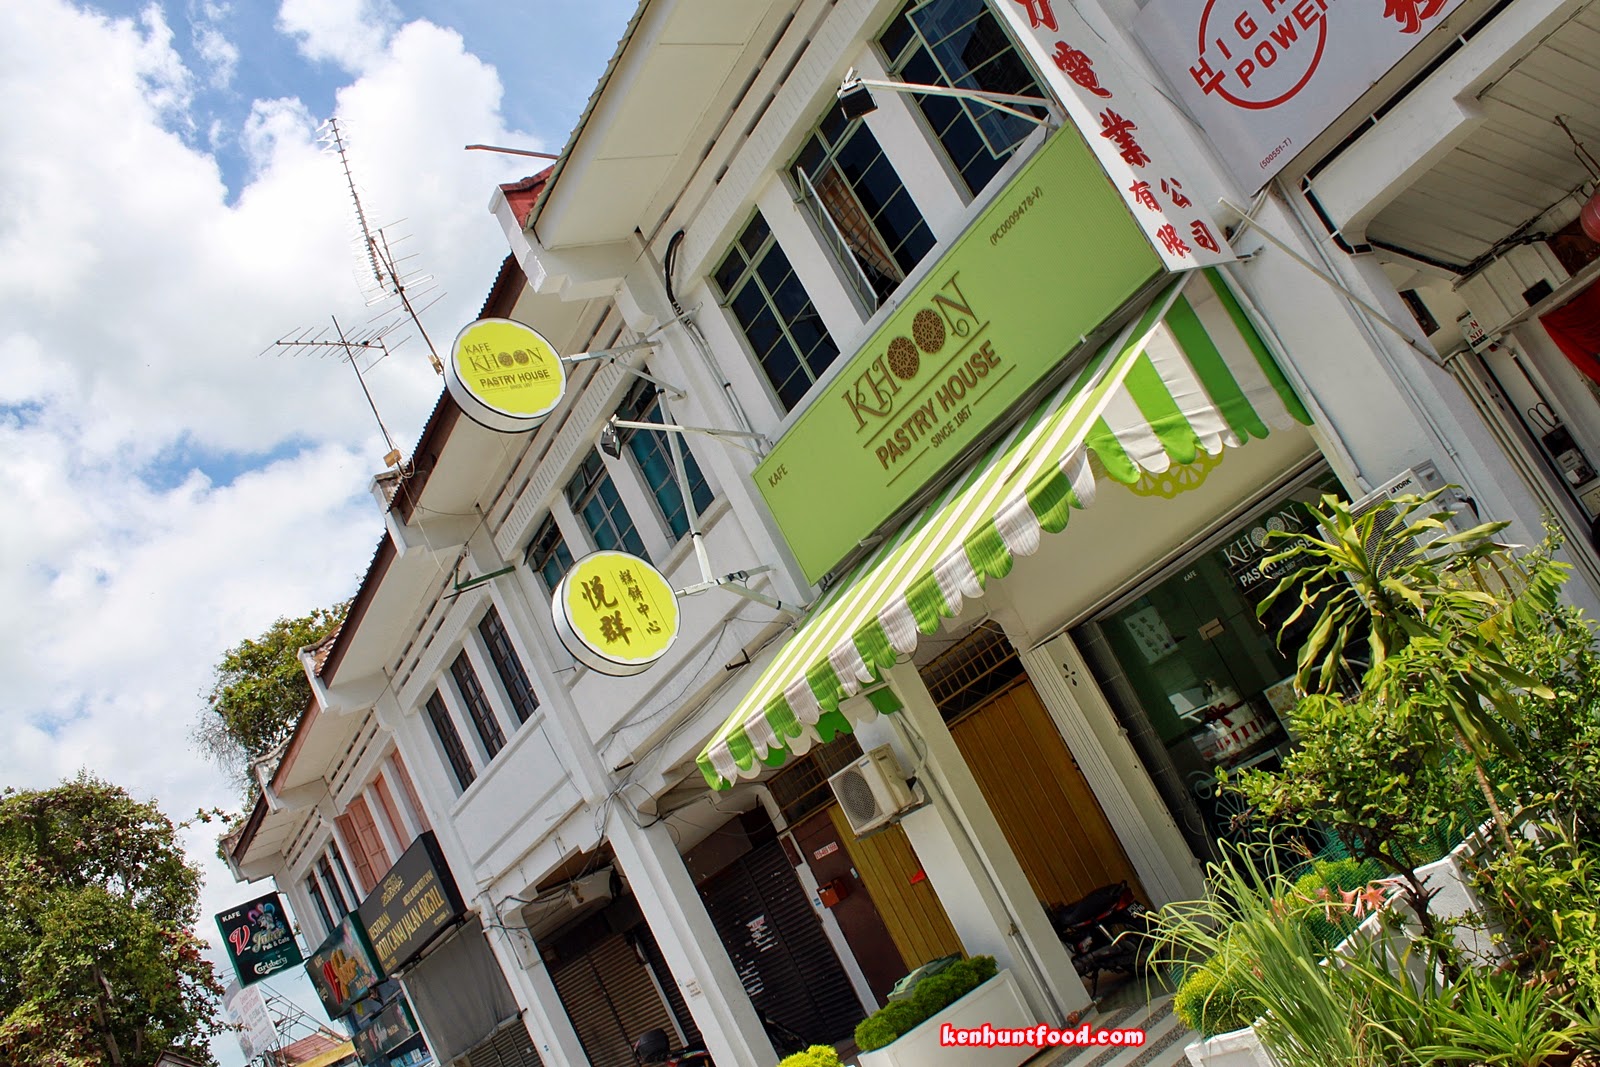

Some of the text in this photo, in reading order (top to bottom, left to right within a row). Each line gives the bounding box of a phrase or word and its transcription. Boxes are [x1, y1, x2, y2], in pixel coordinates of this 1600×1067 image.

[1235, 0, 1329, 88] POWE
[1259, 136, 1293, 170] (500551-T)
[989, 186, 1044, 246] (PC0009478-V)
[464, 342, 491, 355] KAFE
[468, 347, 545, 374] KHOON
[841, 271, 980, 433] KHOON
[480, 369, 551, 389] PASTRY HOUSE
[875, 340, 1002, 470] PASTRY HOUSE
[930, 421, 956, 448] SINCE
[768, 463, 788, 488] KAFE
[1394, 477, 1413, 493] YORK
[1222, 503, 1304, 569] KHOON
[1184, 570, 1197, 582] KAFE
[222, 911, 241, 922] KAFE
[375, 936, 393, 962] ROTI
[386, 921, 408, 950] CANAI
[401, 905, 423, 941] JALAN
[417, 885, 445, 921] ARGYLL
[253, 956, 288, 975] Carlsberg
